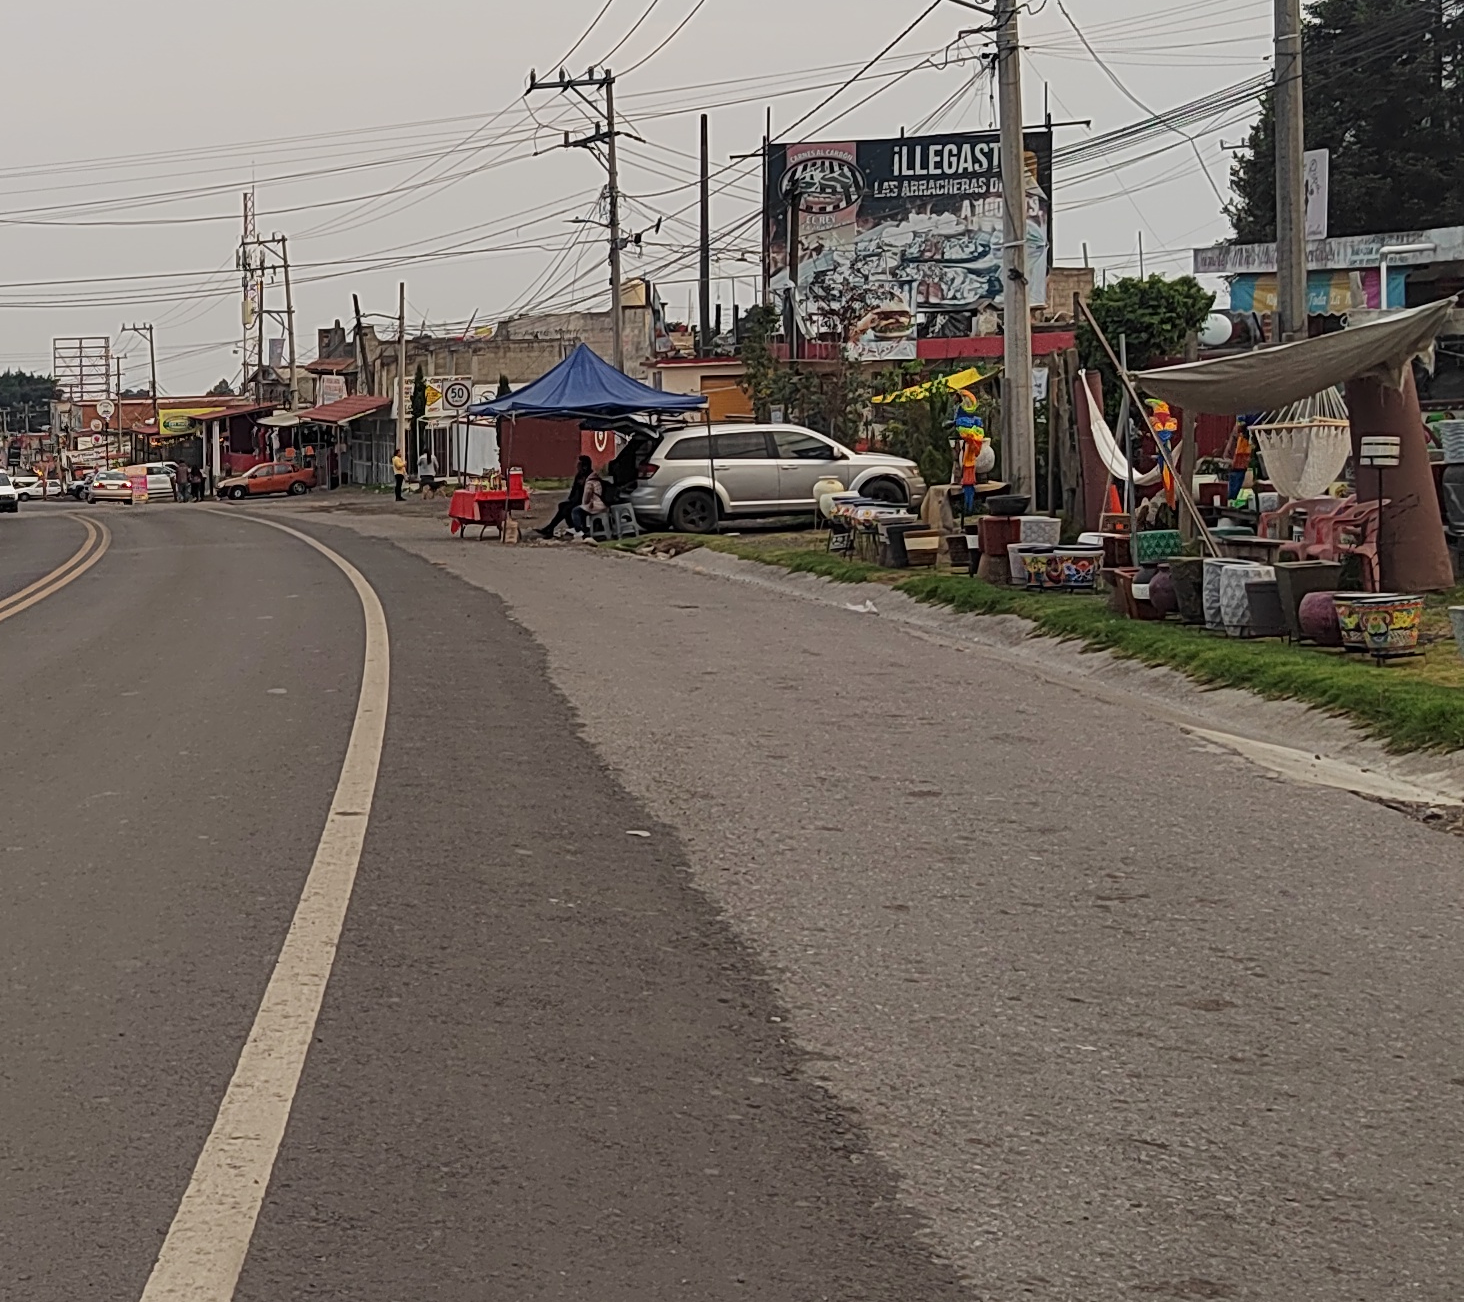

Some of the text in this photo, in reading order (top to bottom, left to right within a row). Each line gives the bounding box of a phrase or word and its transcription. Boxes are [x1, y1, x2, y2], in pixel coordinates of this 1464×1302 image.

[790, 150, 815, 163] CARNES
[893, 143, 1002, 176] ¡LLEGAST
[873, 177, 1003, 198] LAS ARRACHERAS D
[450, 387, 464, 399] 50
